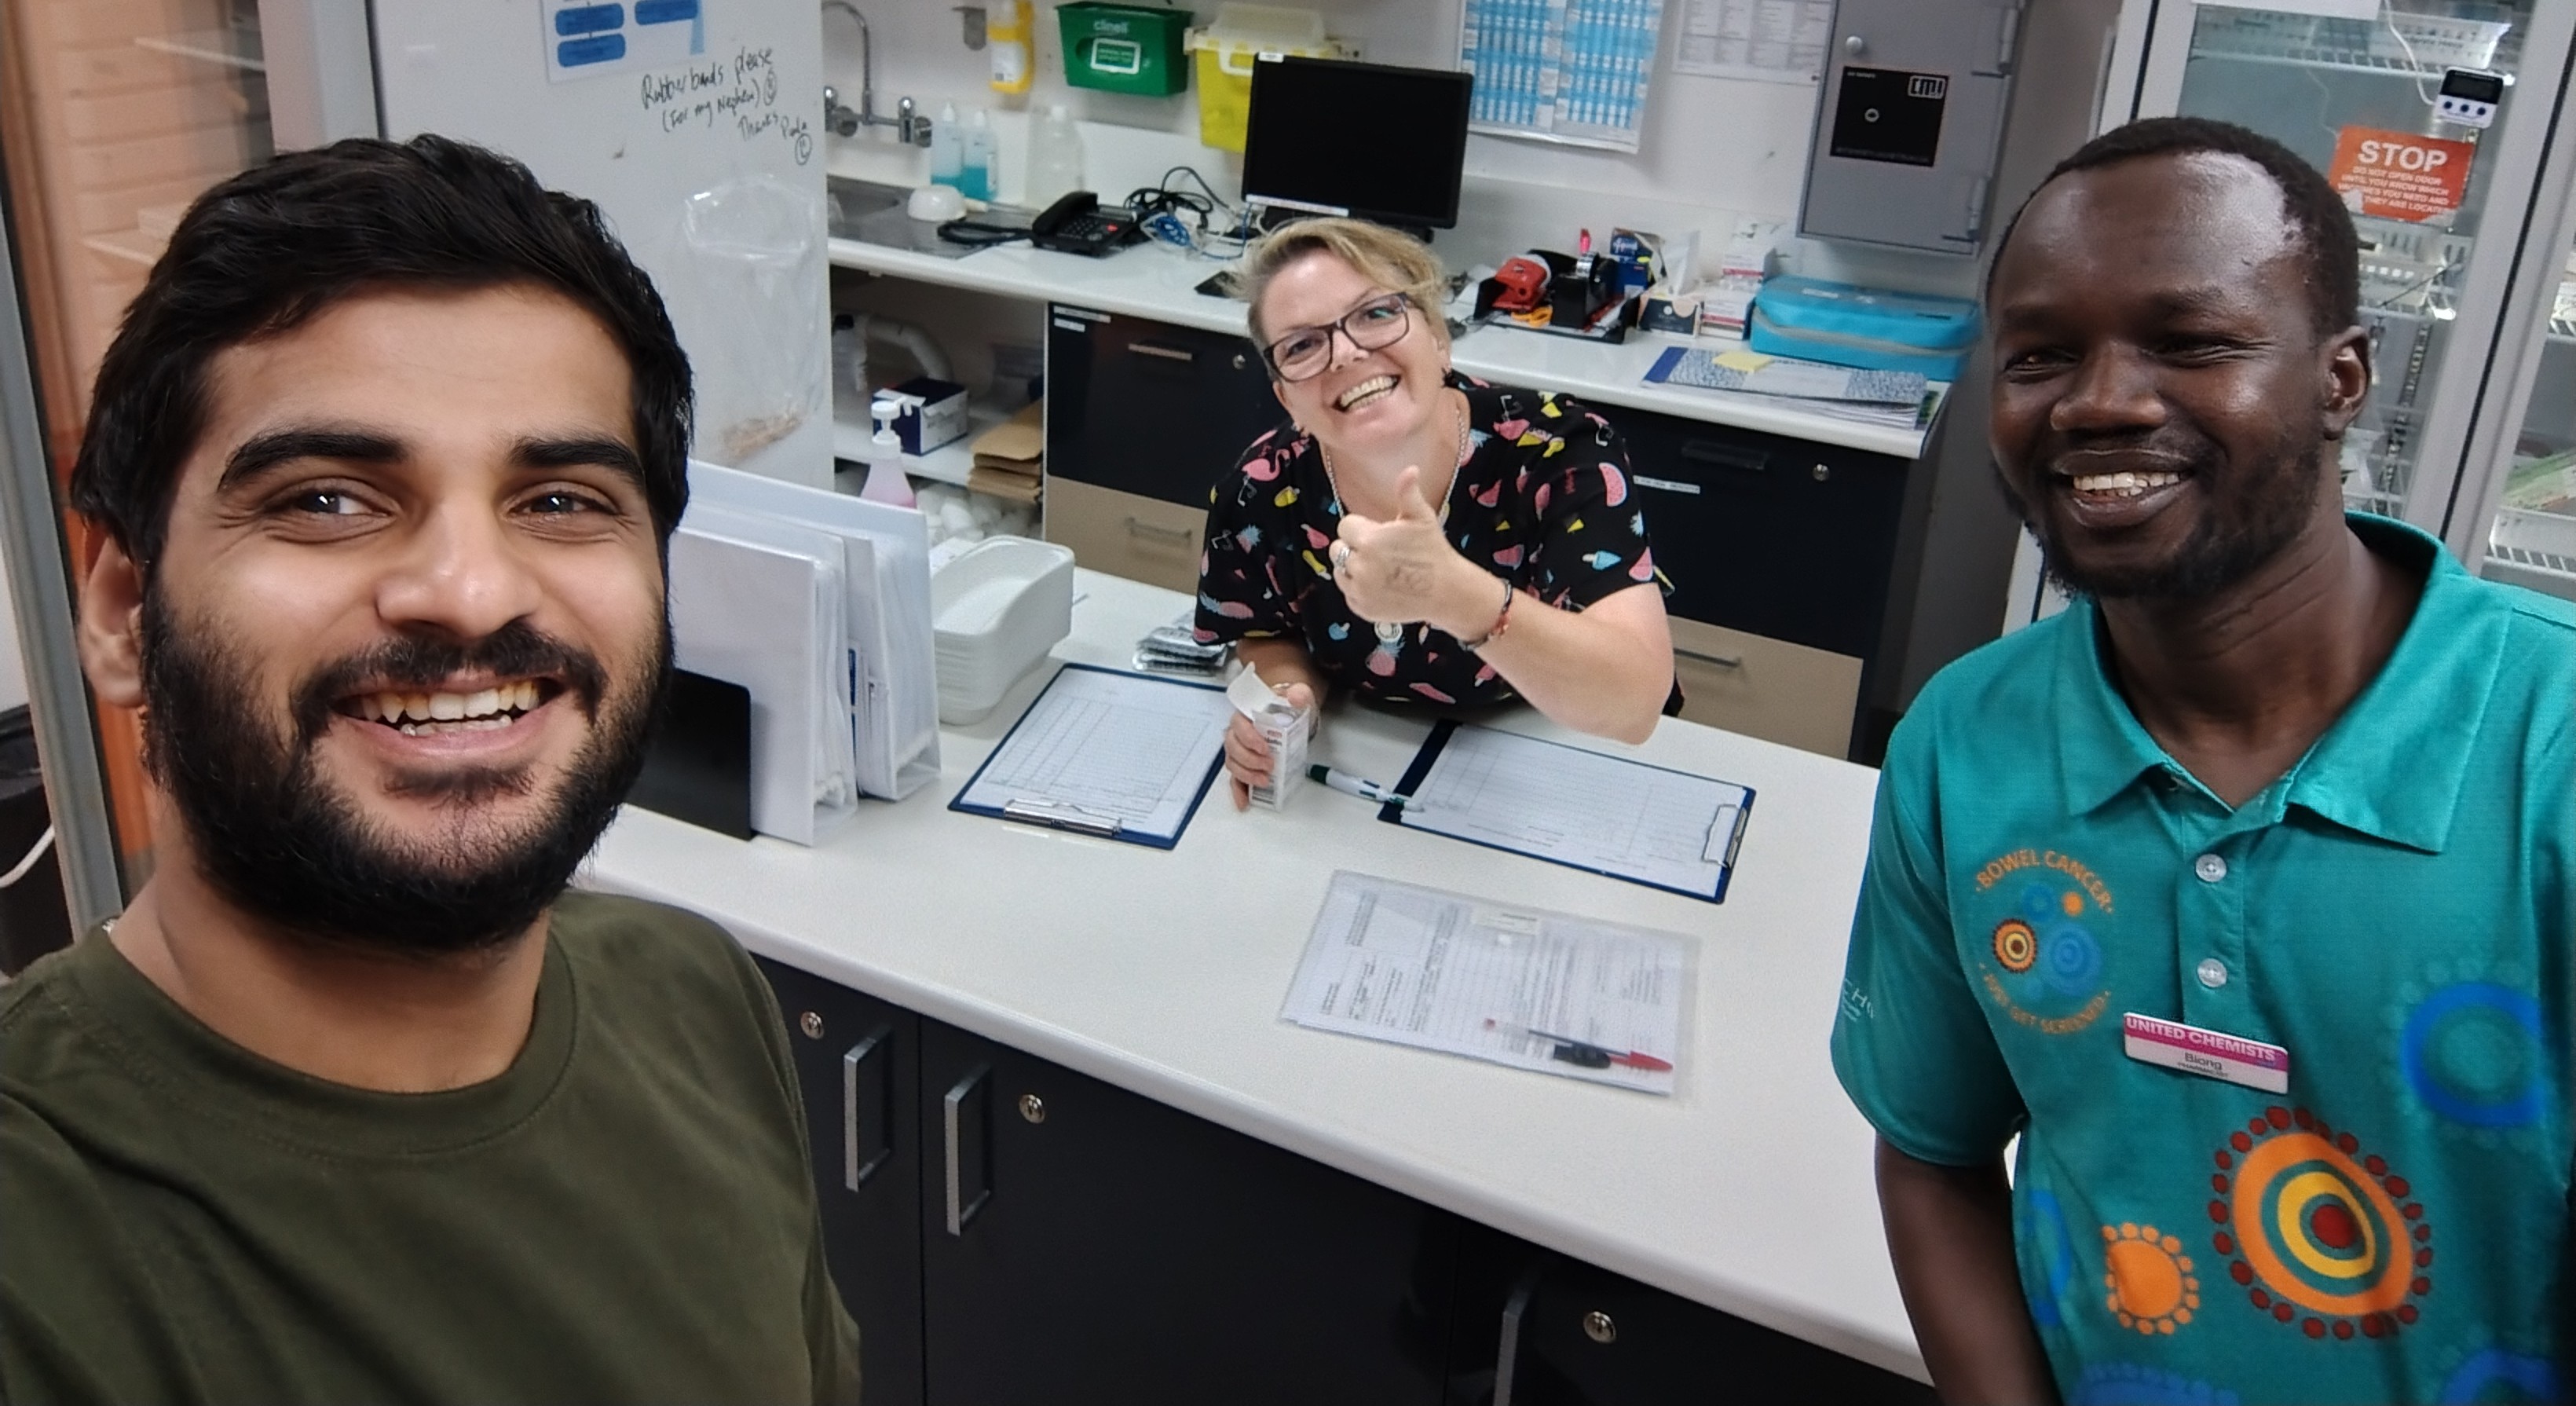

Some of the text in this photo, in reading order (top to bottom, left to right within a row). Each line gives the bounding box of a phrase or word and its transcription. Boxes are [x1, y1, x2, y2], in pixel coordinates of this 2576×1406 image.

[641, 46, 773, 111] Rubber bands please
[694, 101, 713, 127] my
[2357, 140, 2448, 173] STOP
[2341, 174, 2450, 196] UNTIL YOU KNOW WHICH
[2353, 166, 2442, 185] DO NOT OPEN DOOR
[2383, 189, 2403, 199] YOU
[2403, 192, 2428, 203] NEED
[2428, 196, 2449, 206] AND
[2388, 199, 2407, 209] ARE
[1977, 849, 2113, 909] BOWEL CANCER
[2126, 1017, 2276, 1060] UNITED CHEMISTS
